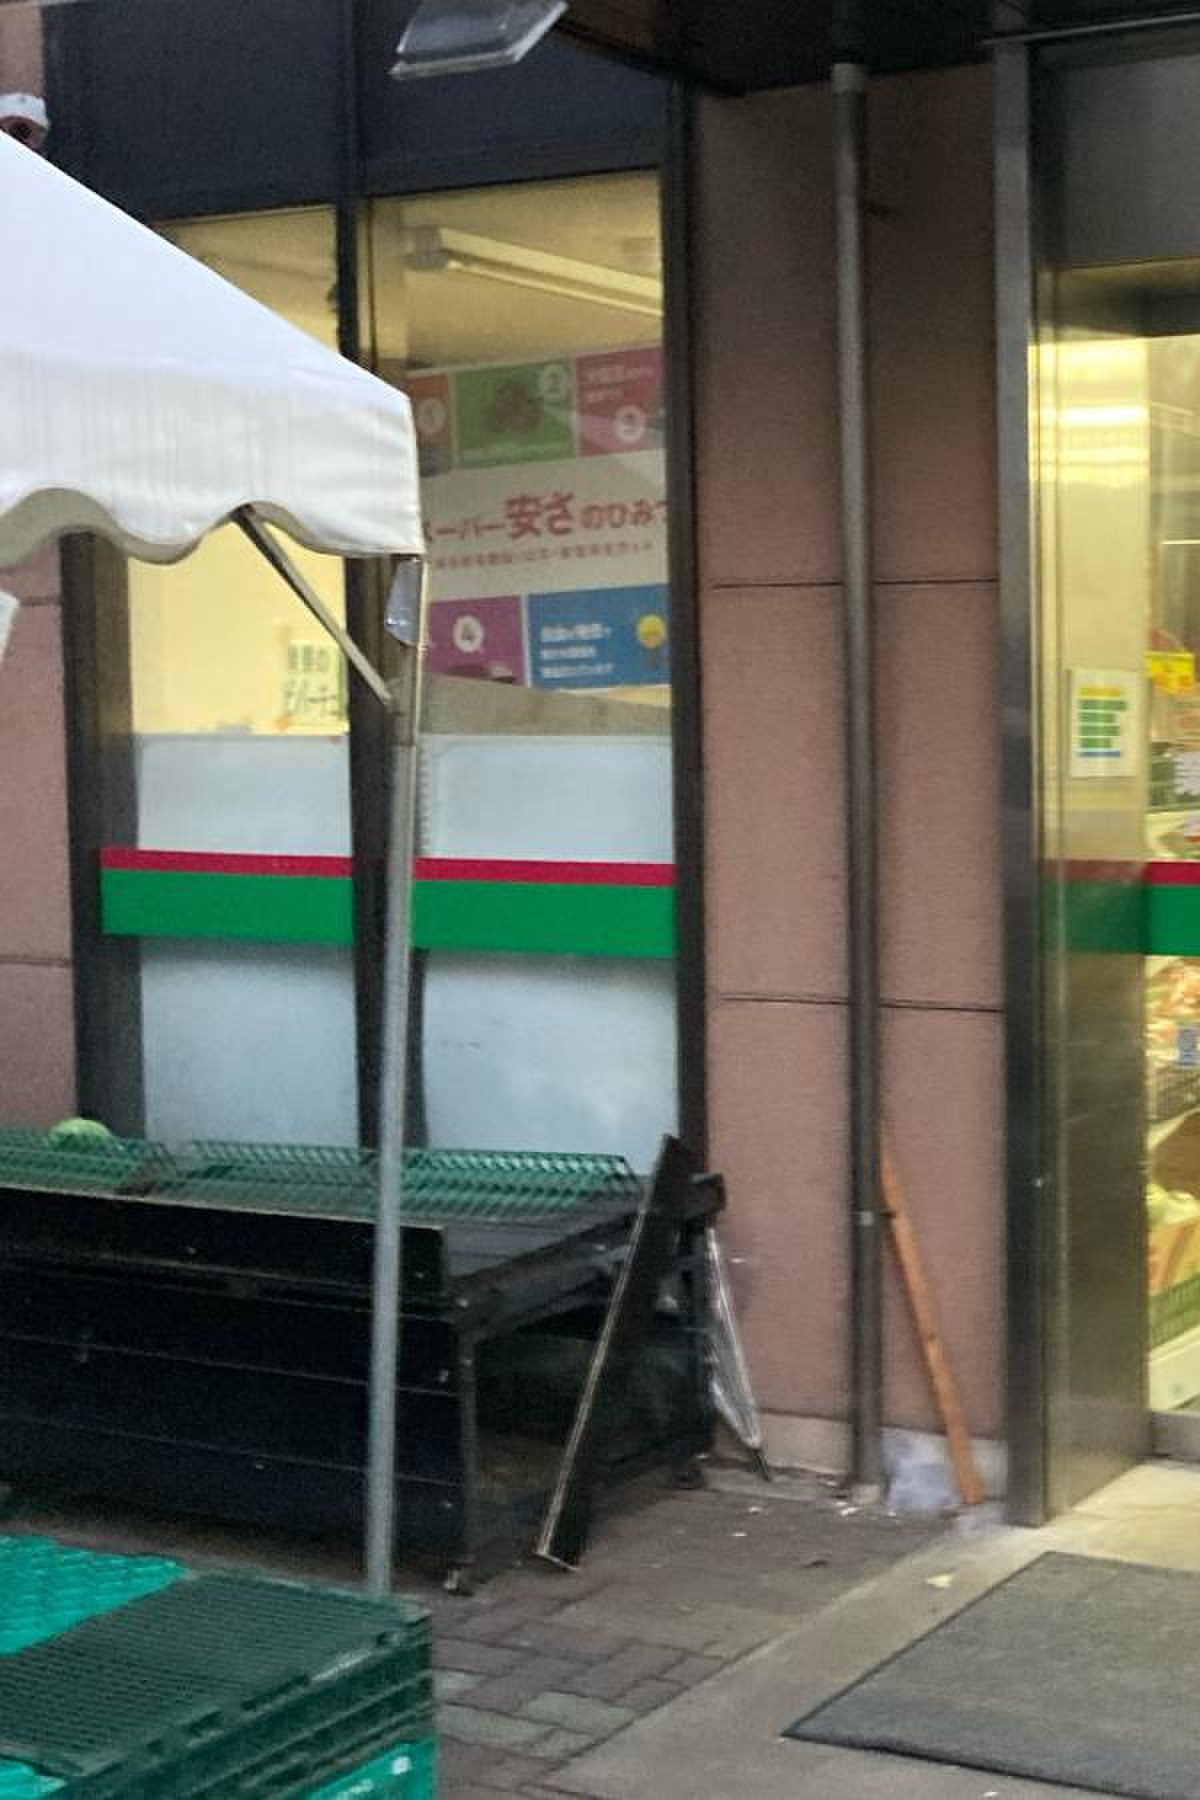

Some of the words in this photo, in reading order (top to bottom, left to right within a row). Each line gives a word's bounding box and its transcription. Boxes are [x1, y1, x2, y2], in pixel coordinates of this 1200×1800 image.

[425, 491, 667, 542] ーパー安さのひみ
